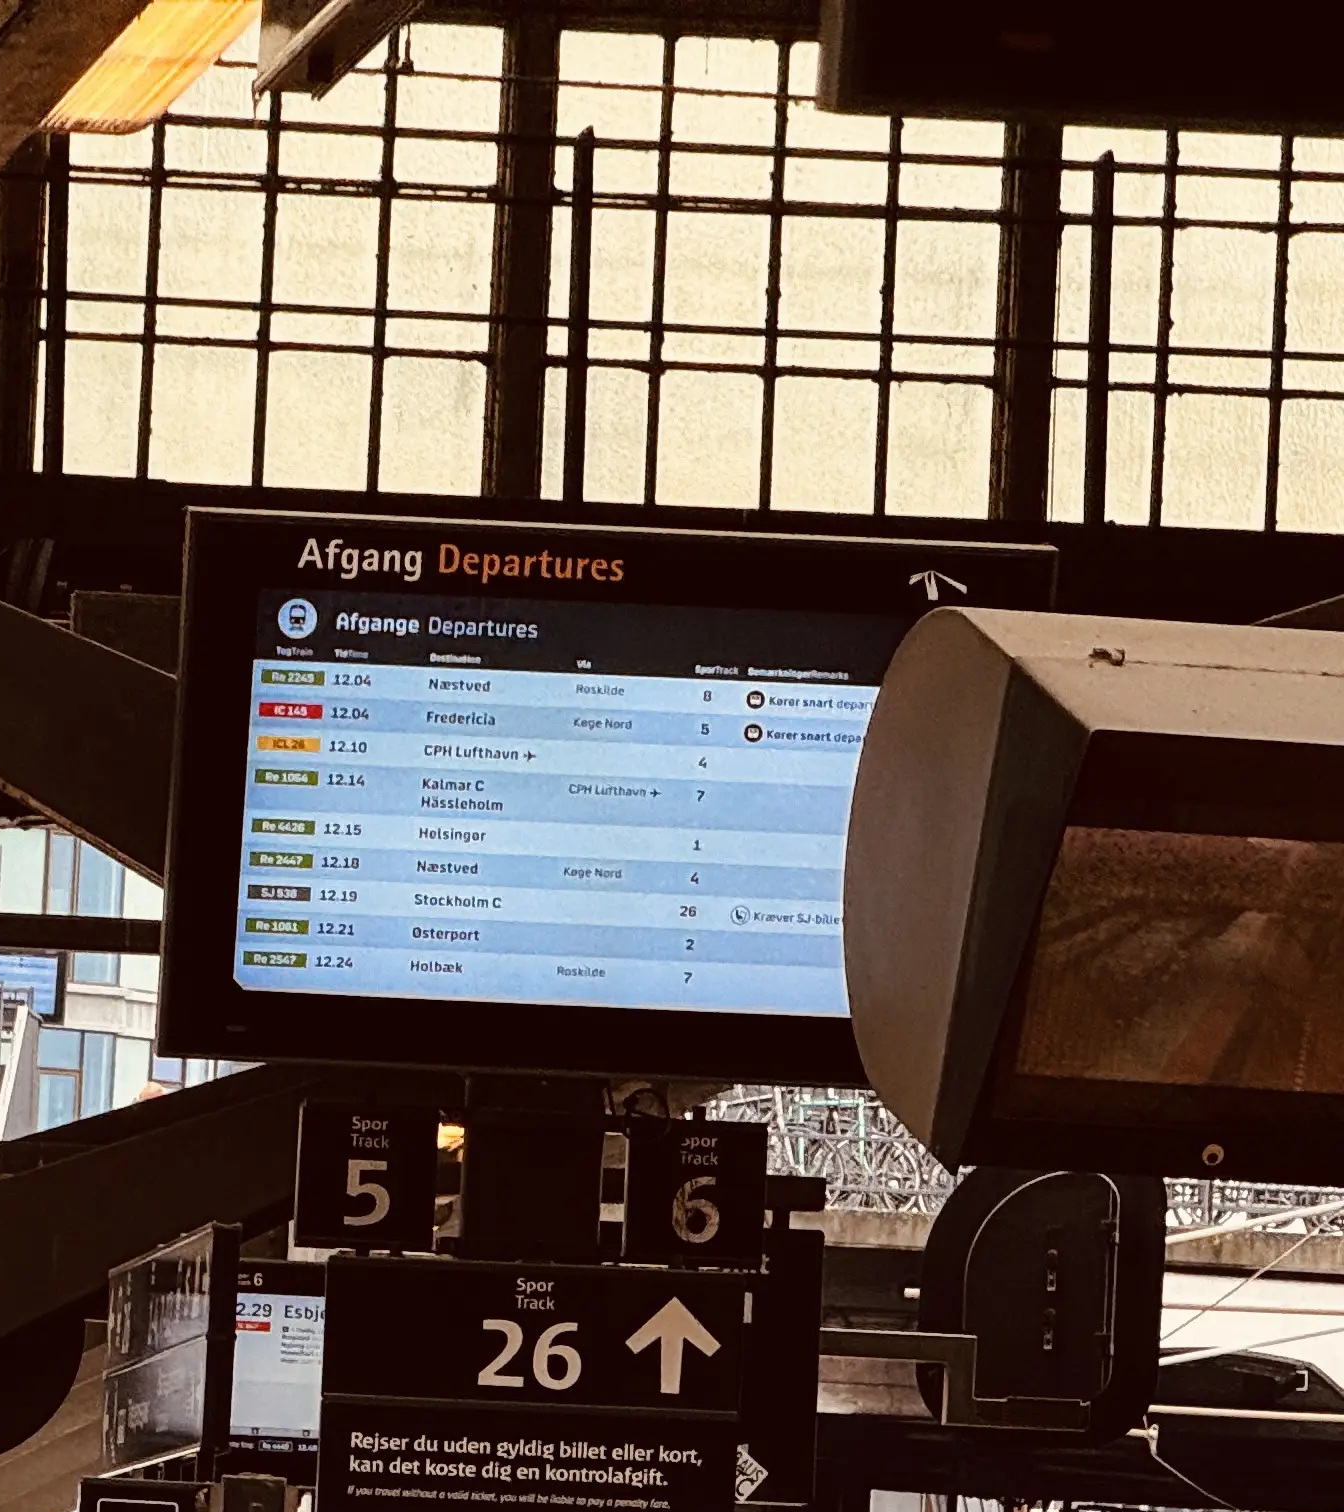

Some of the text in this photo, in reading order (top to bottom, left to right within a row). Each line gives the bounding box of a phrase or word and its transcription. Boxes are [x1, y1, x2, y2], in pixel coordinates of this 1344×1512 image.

[298, 538, 625, 584] Afgang Departures
[335, 612, 539, 640] Afgange Departures
[333, 674, 372, 688] 12.04
[428, 678, 491, 693] Næstved
[575, 684, 625, 697] Roskilde
[702, 690, 712, 702] 8
[802, 697, 833, 709] snart
[330, 707, 370, 721] 12.04
[426, 711, 496, 727] Fredericia
[605, 718, 633, 731] Nord
[700, 723, 710, 736] 5
[800, 731, 831, 744] snart
[328, 740, 368, 754] 12.10
[455, 745, 519, 761] Lufthavn
[698, 756, 708, 769] 4
[327, 774, 365, 787] 12.14
[422, 778, 473, 792] Kalmar
[474, 780, 485, 792] C
[594, 785, 647, 799] Lufthavn
[696, 790, 706, 802] 7
[323, 823, 362, 836] 12.15
[692, 839, 702, 851] 1
[321, 856, 360, 870] 12.18
[416, 860, 479, 876] Næstved
[594, 868, 622, 879] Nord
[690, 872, 700, 885] 4
[319, 890, 358, 903] 12.19
[414, 893, 489, 909] Stockholm
[492, 897, 503, 910] C
[679, 905, 697, 918] 26
[316, 923, 355, 936] 12.21
[685, 939, 695, 951] 2
[314, 956, 354, 969] 12.24
[409, 959, 463, 974] Holbæk
[556, 966, 606, 978] Roskilde
[683, 972, 693, 985] 7
[352, 1115, 389, 1132] Spor
[350, 1133, 390, 1149] Track
[679, 1150, 719, 1166] Track
[343, 1158, 391, 1226] 5
[672, 1176, 720, 1244] 6
[253, 1272, 263, 1287] 6
[516, 1277, 555, 1295] Spor
[236, 1302, 273, 1318] 2.29
[515, 1294, 556, 1311] Track
[477, 1319, 582, 1390] 26
[350, 1431, 703, 1467] Rejser du uden gyldig billet eller kort,
[349, 1454, 669, 1488] kan det koste dig en kontrolafgift.
